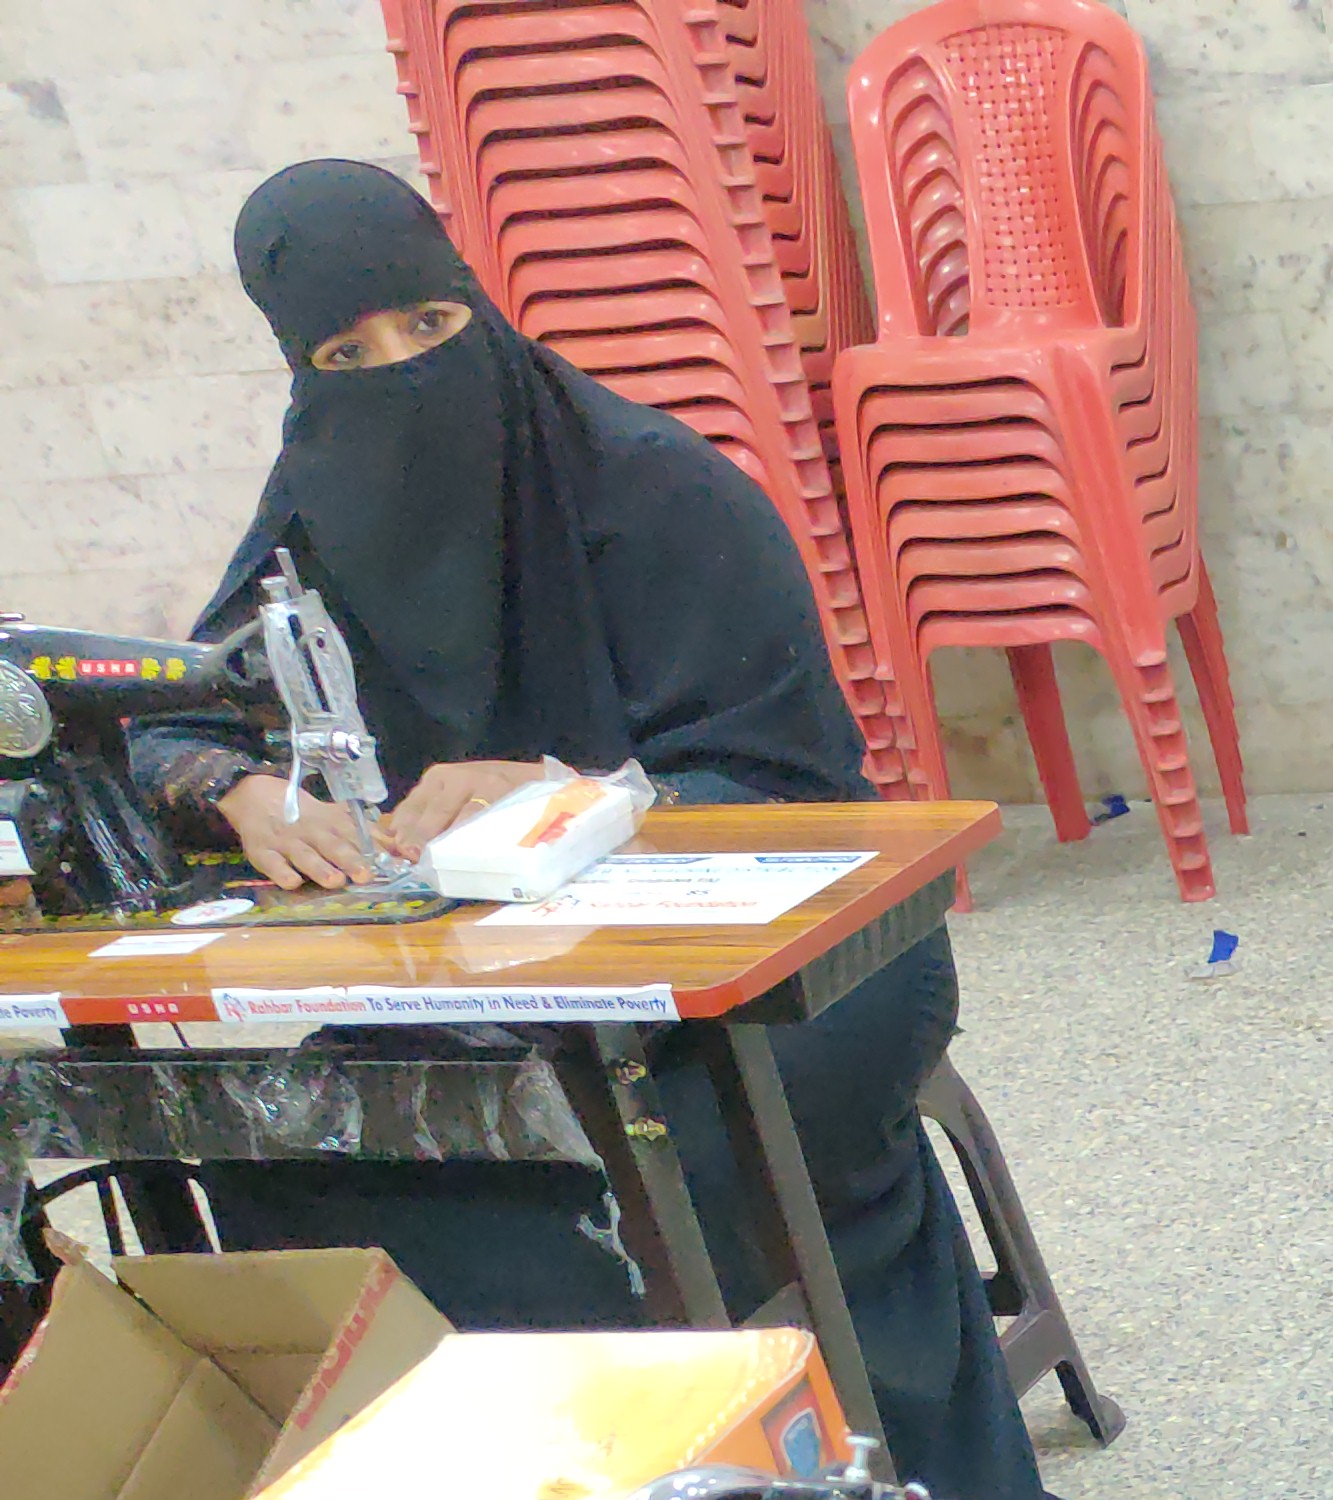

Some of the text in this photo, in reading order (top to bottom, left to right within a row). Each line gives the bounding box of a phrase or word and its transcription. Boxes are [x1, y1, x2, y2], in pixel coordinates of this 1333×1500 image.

[82, 662, 135, 674] USHA
[250, 1000, 293, 1015] Rahbar
[298, 998, 367, 1014] Foundation
[368, 997, 383, 1011] To
[386, 997, 422, 1011] Serve
[425, 996, 485, 1013] Humanity
[488, 996, 501, 1010] in
[505, 995, 539, 1010] Need
[542, 996, 551, 1010] &
[555, 995, 615, 1010] Eliminate
[618, 994, 667, 1013] Poverty
